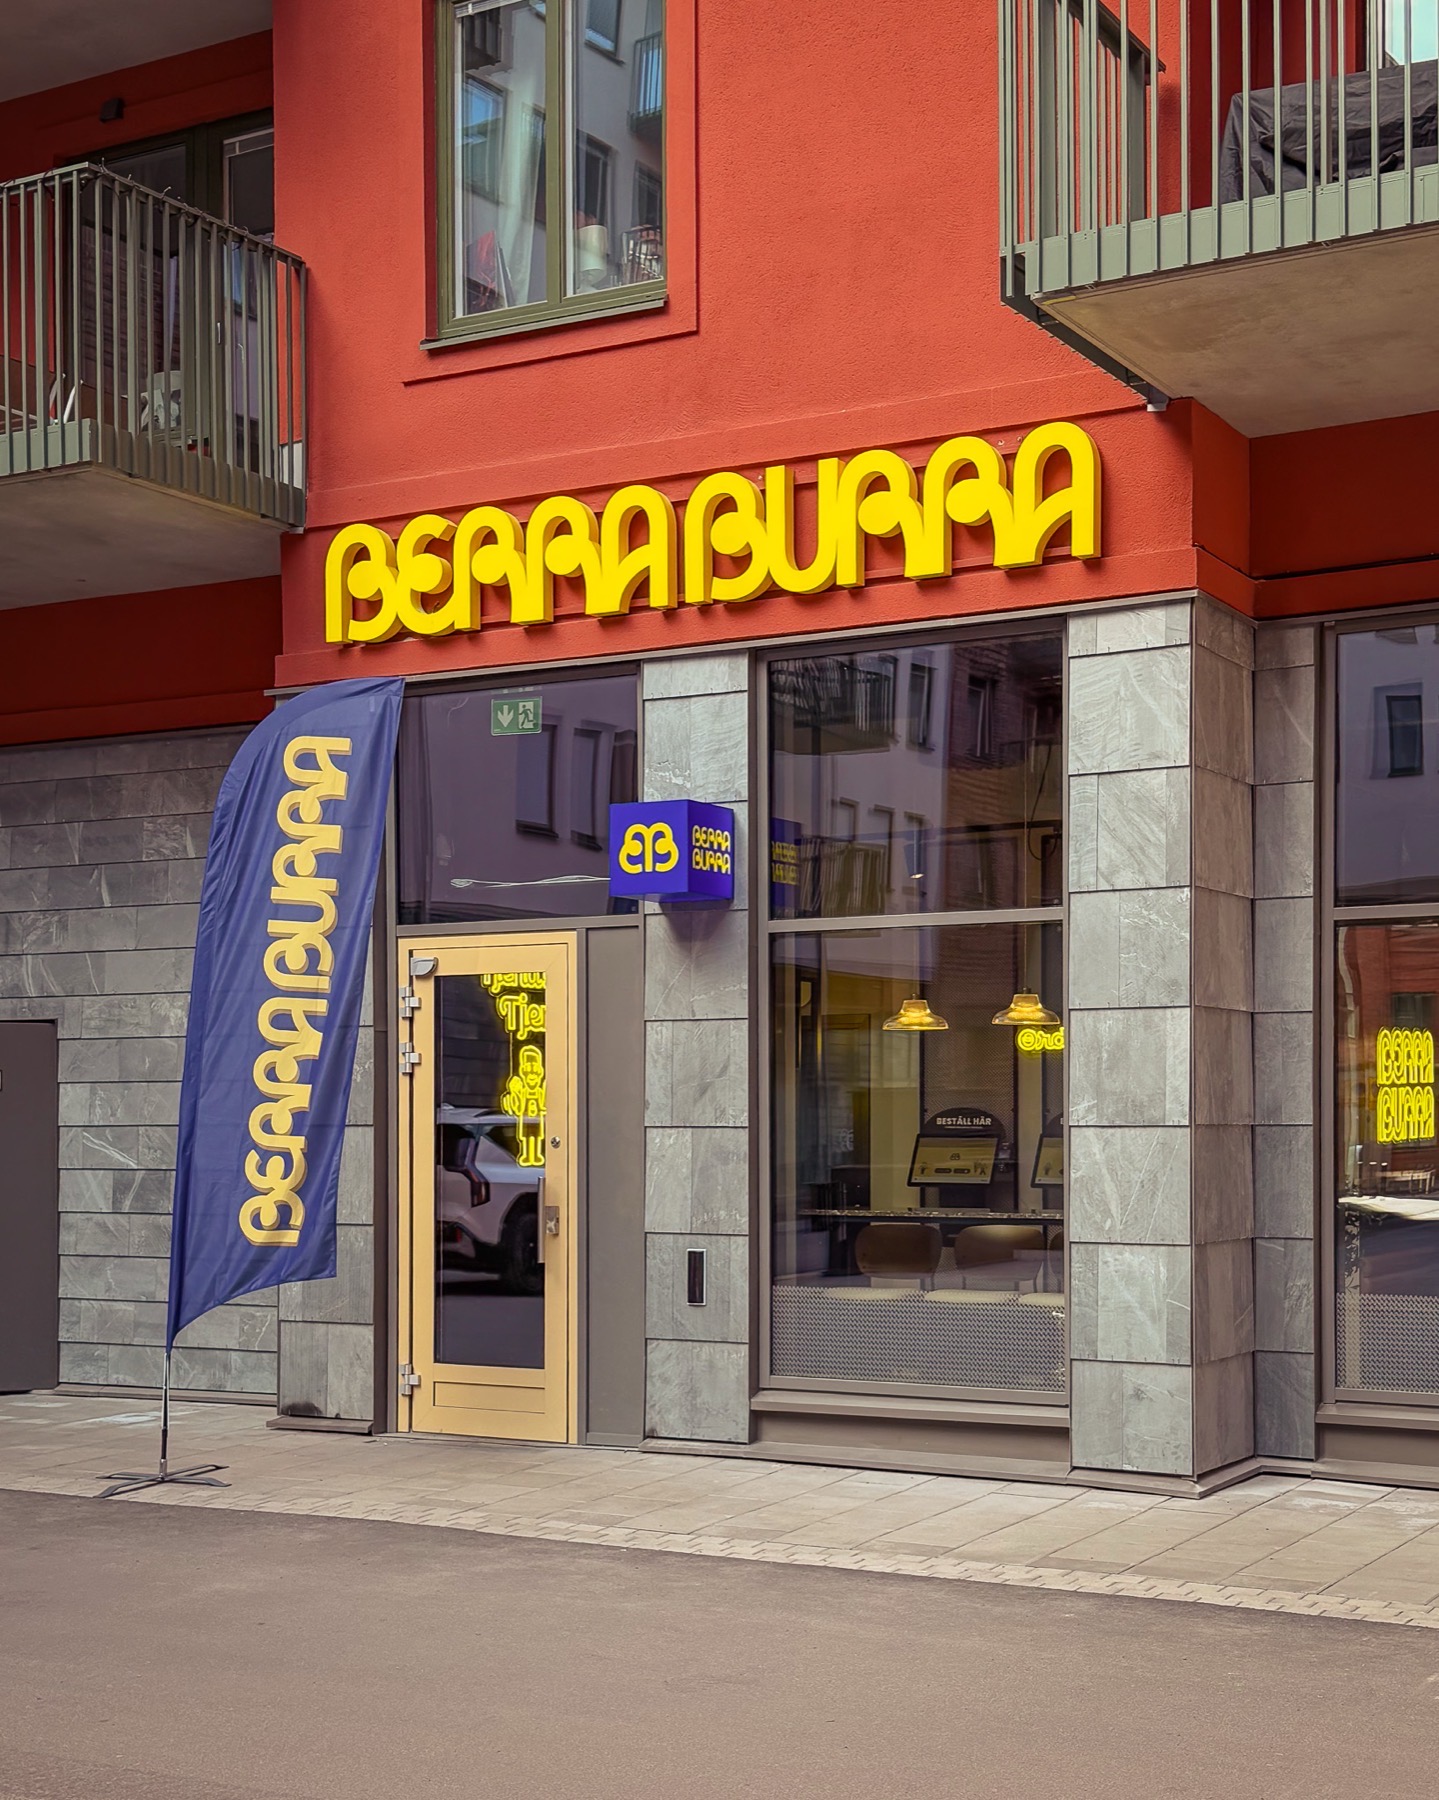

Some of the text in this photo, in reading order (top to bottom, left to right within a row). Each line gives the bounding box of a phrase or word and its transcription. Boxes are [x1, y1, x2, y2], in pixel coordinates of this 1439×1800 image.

[692, 824, 731, 852] BERRA
[692, 848, 731, 875] BURRA
[1376, 1028, 1435, 1085] BERRA
[936, 1115, 992, 1126] BESTÄLL HÄR
[1376, 1086, 1435, 1143] BURRA
